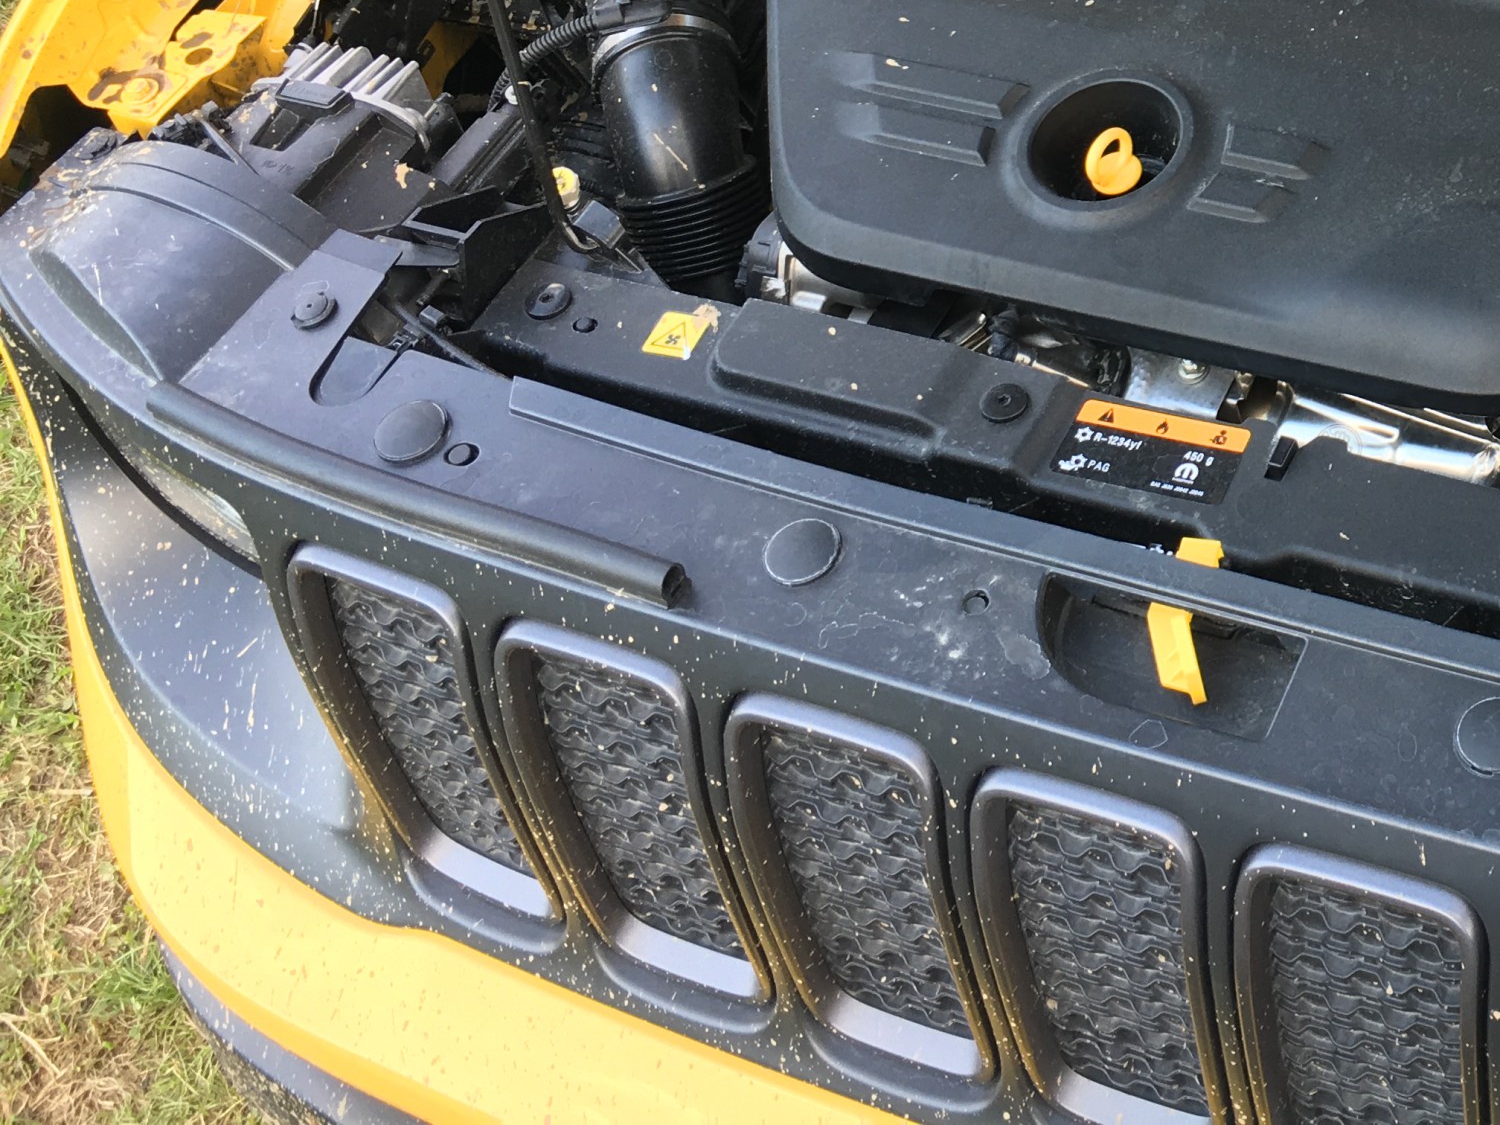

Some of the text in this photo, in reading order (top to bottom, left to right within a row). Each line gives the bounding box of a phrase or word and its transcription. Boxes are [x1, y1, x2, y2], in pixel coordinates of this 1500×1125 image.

[1093, 431, 1144, 451] R-1234yf
[1086, 459, 1111, 473] PAG
[1183, 450, 1214, 467] 450 g
